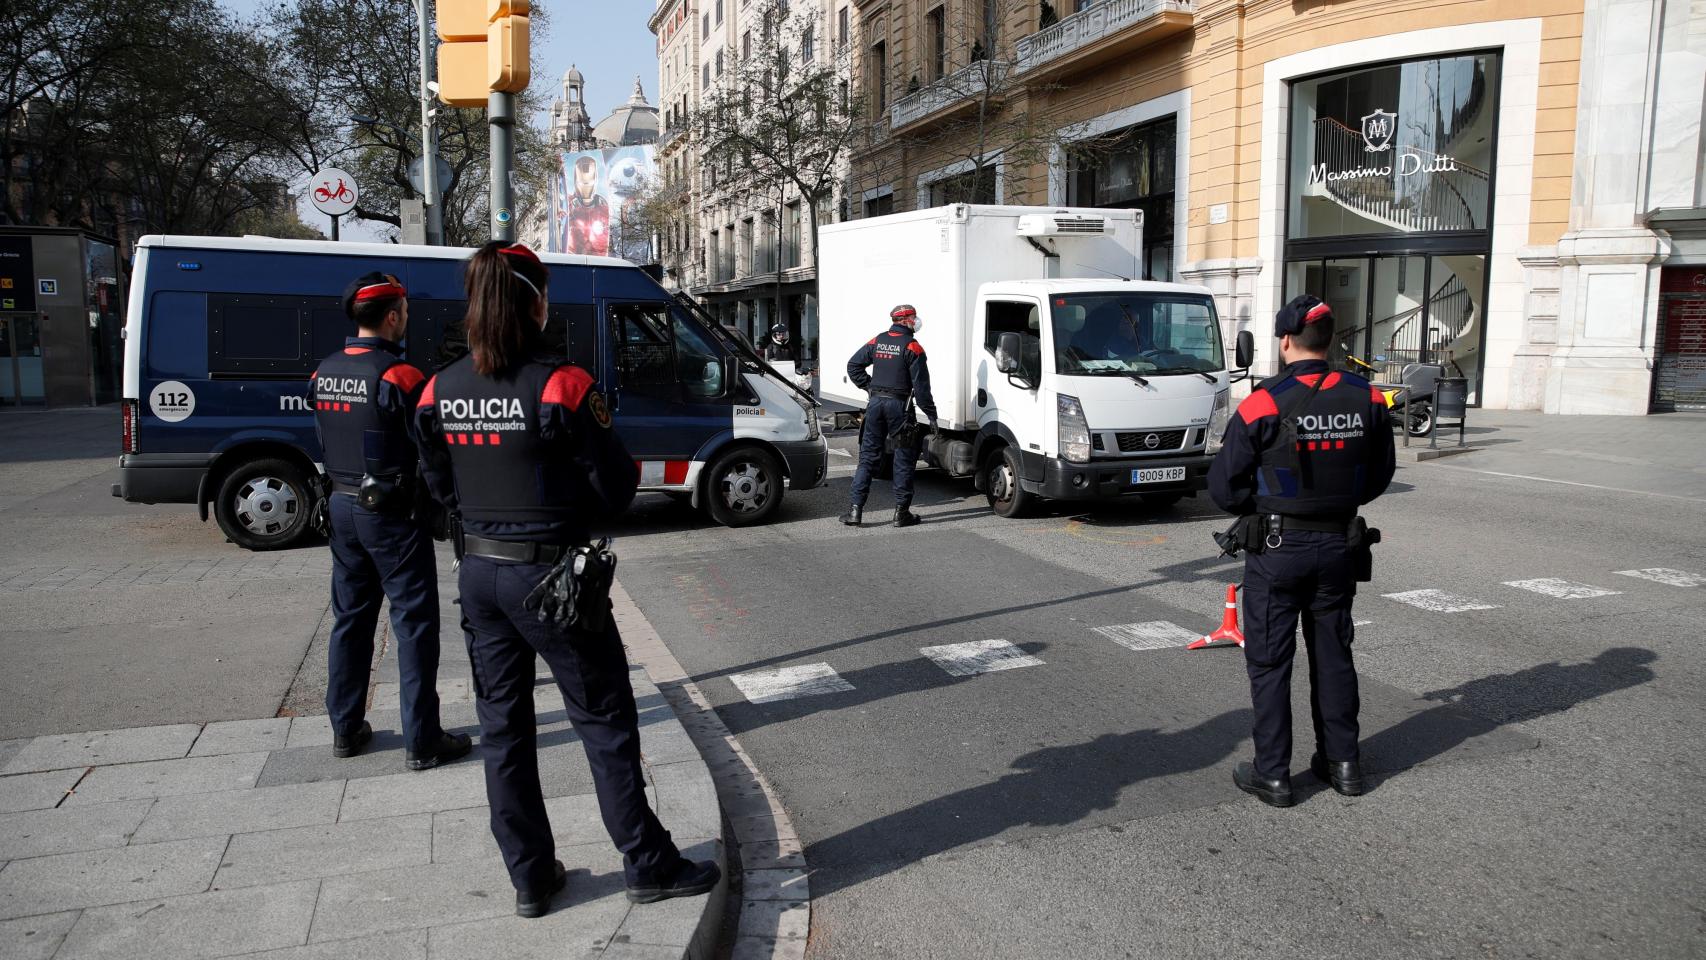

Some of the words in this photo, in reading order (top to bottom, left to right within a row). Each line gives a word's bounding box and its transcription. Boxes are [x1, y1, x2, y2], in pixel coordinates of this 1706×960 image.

[1308, 163, 1391, 185] Massimo
[1400, 153, 1459, 176] Dutti
[877, 344, 900, 352] POLICIA
[317, 377, 368, 395] POLICIA
[158, 392, 189, 407] 112
[440, 398, 525, 419] POLICIA
[736, 407, 760, 416] policia
[443, 422, 473, 431] mossos
[474, 420, 526, 433] d'esquadra
[1139, 470, 1164, 482] 9009
[1166, 468, 1184, 480] KBP
